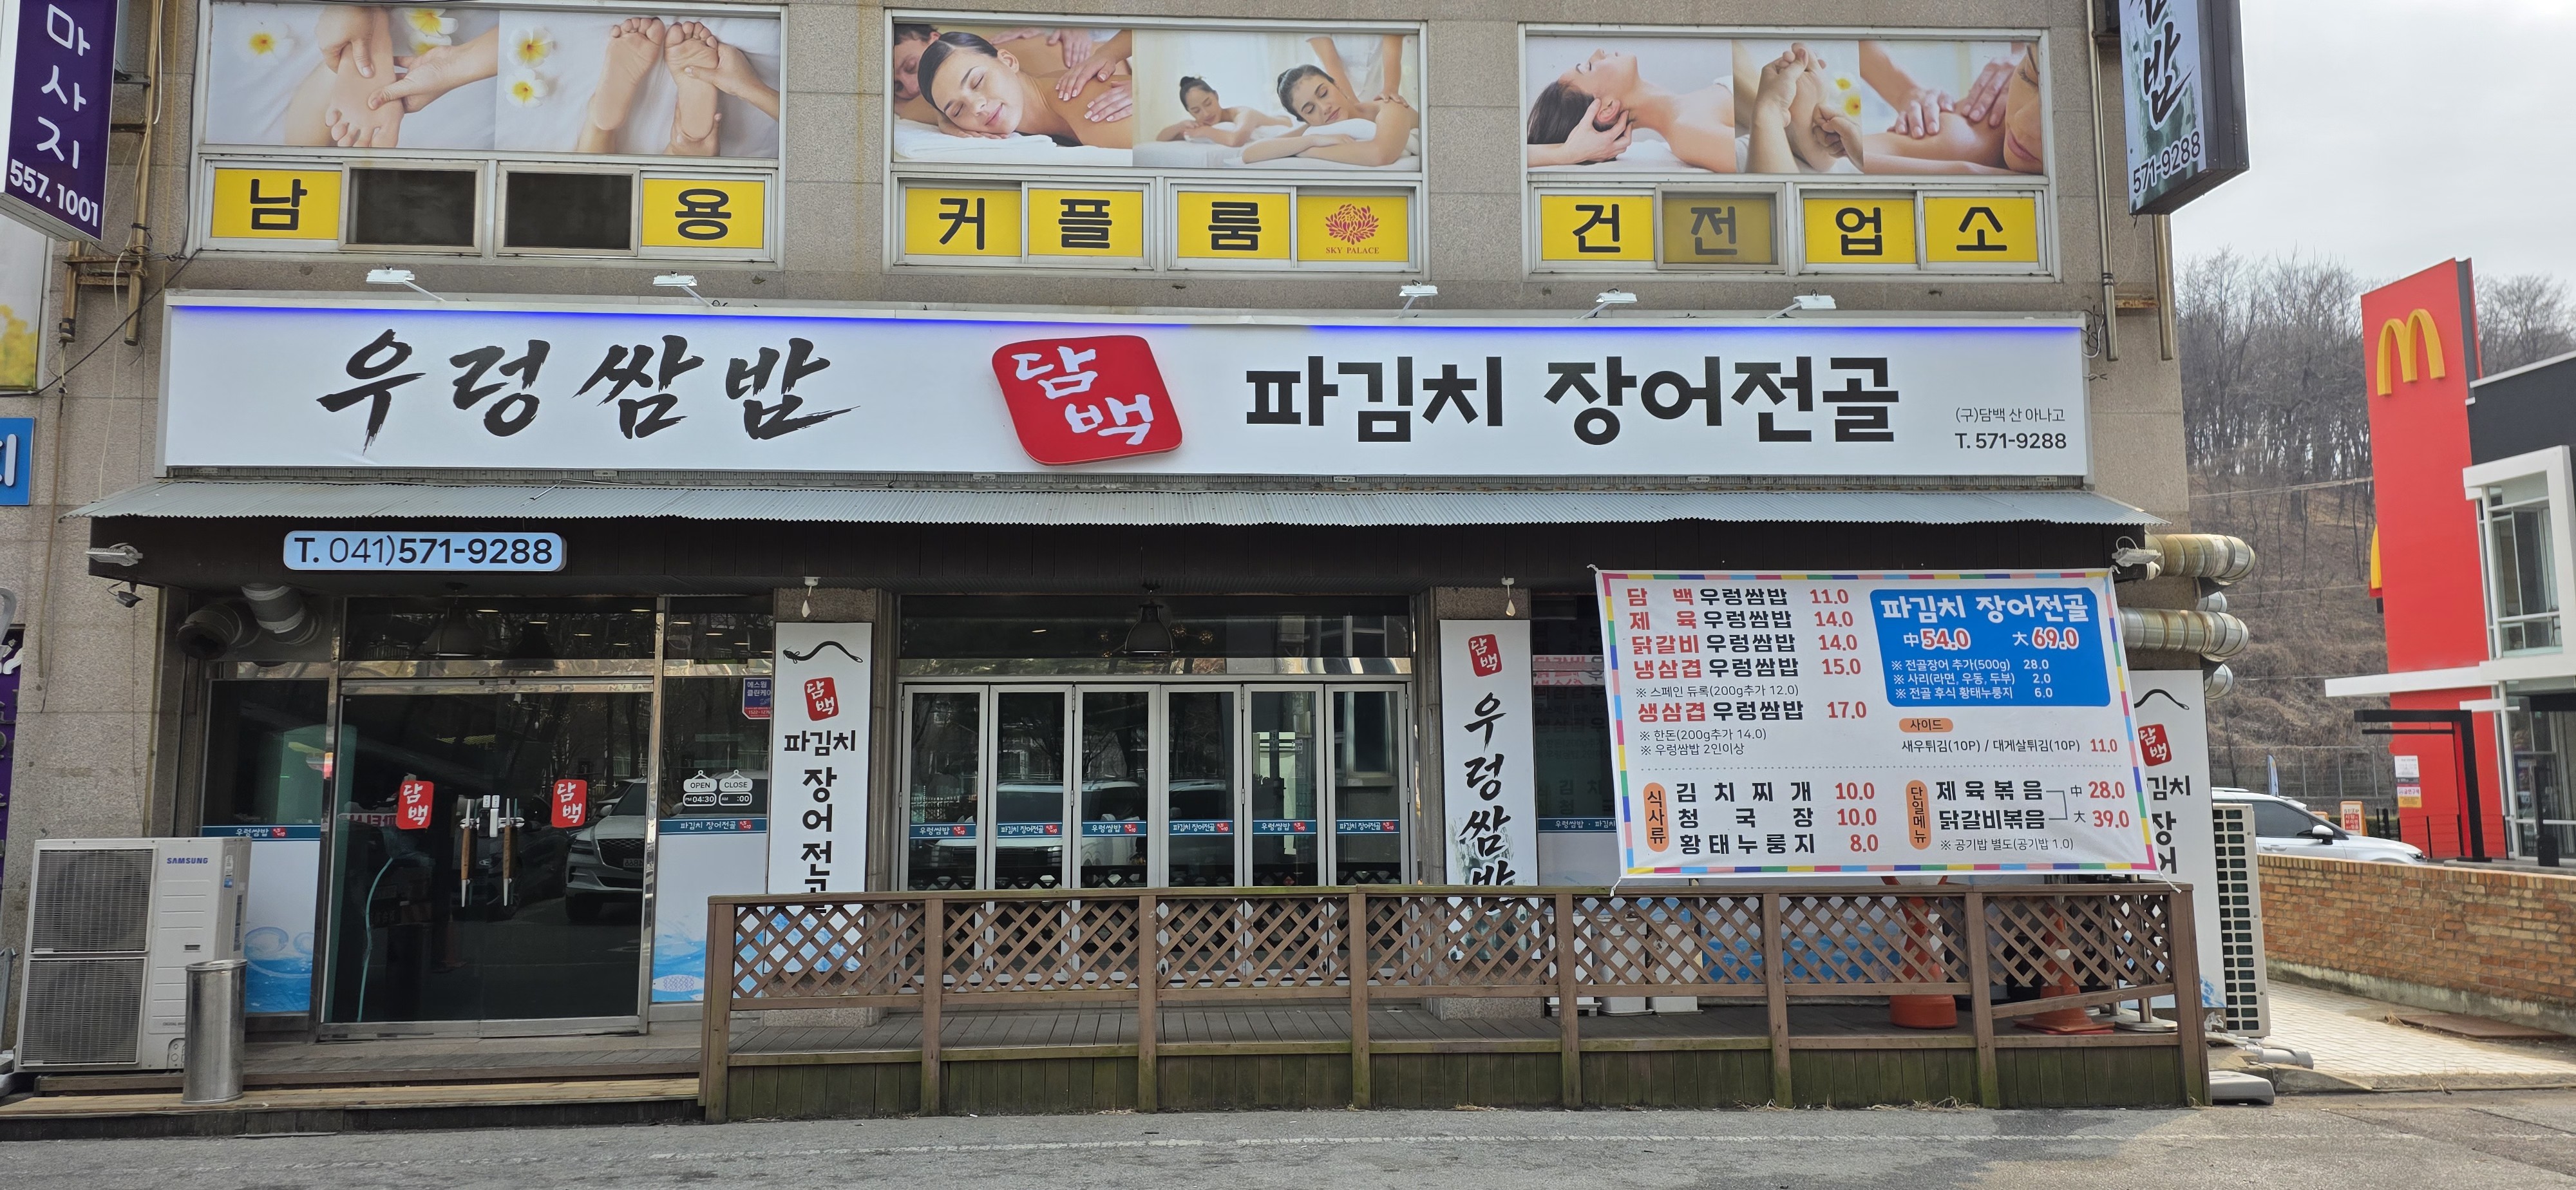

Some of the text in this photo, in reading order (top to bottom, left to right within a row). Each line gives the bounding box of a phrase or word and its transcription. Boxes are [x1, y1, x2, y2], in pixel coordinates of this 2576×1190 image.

[37, 4, 90, 169] 마사지
[2133, 131, 2201, 194] 571-9288
[9, 158, 99, 228] 557.1001
[250, 178, 307, 231] 남
[675, 189, 732, 240] 용
[316, 329, 860, 456] 우렁쌈밥
[1011, 346, 1154, 445] 담백
[1246, 355, 1899, 446] 파김치 장어전골
[1956, 407, 2065, 422] (구)담백 산 아나고
[1955, 433, 2067, 449] T. 571-9288
[294, 535, 553, 566] T. 041)571-9288
[1700, 587, 1787, 606] 우렁쌈밥
[1810, 589, 1849, 604] 11.0
[1704, 610, 1792, 628] 우렁쌈밥
[1814, 611, 1853, 627] 14.0
[1880, 594, 2089, 623] 파김치 장어전골
[1631, 634, 1858, 655] 닭갈비 우렁쌈밥 14.0
[1920, 628, 1971, 650] 54.0
[2032, 627, 2079, 650] 69.0
[1634, 657, 1861, 679] 냉삼겹 우렁쌈밥 15.0
[1905, 659, 2049, 671] 전골장어 추가(500g) 28.0
[1990, 674, 2015, 685] 두부)
[2033, 674, 2051, 684] 2.0
[1651, 686, 1684, 698] 스페인
[1770, 684, 1799, 696] 12.0)
[1909, 687, 2052, 699] 전골 후식 황태누룽지 6.0
[1638, 701, 1867, 723] 생삼겹 우렁쌈밥 17.0
[1654, 728, 1766, 741] 한돈(200g추가 14.0)
[1910, 719, 1944, 731] 사이드
[784, 730, 856, 756] 파김치
[1654, 743, 1745, 755] 우렁쌈밥 2인이상
[1902, 739, 1981, 753] 새우튀김(10P)
[1993, 739, 2081, 753] 대게살튀김(10P)
[2090, 739, 2117, 753] 11.0
[1835, 782, 1875, 800] 10.0
[2088, 781, 2125, 799] 28.0
[2146, 775, 2191, 800] 김치
[403, 783, 428, 826] 담백
[557, 782, 582, 823] 담백
[1555, 820, 1615, 829] 우렁쌈밥 파김치
[1647, 790, 1666, 844] 식사류
[1837, 808, 1877, 826] 10.0
[1911, 786, 1927, 844] 단일메뉴
[1939, 809, 2045, 831] 닭갈비볶음
[2092, 809, 2130, 828] 39.0
[919, 827, 950, 835] 우렁쌈밥
[1091, 824, 1121, 833] 우렁쌈밥
[1261, 822, 1290, 831] 우렁쌈밥
[1850, 834, 1879, 852] 8.0
[1954, 838, 2073, 851] 공기밥 별도(공기밥 1.0)
